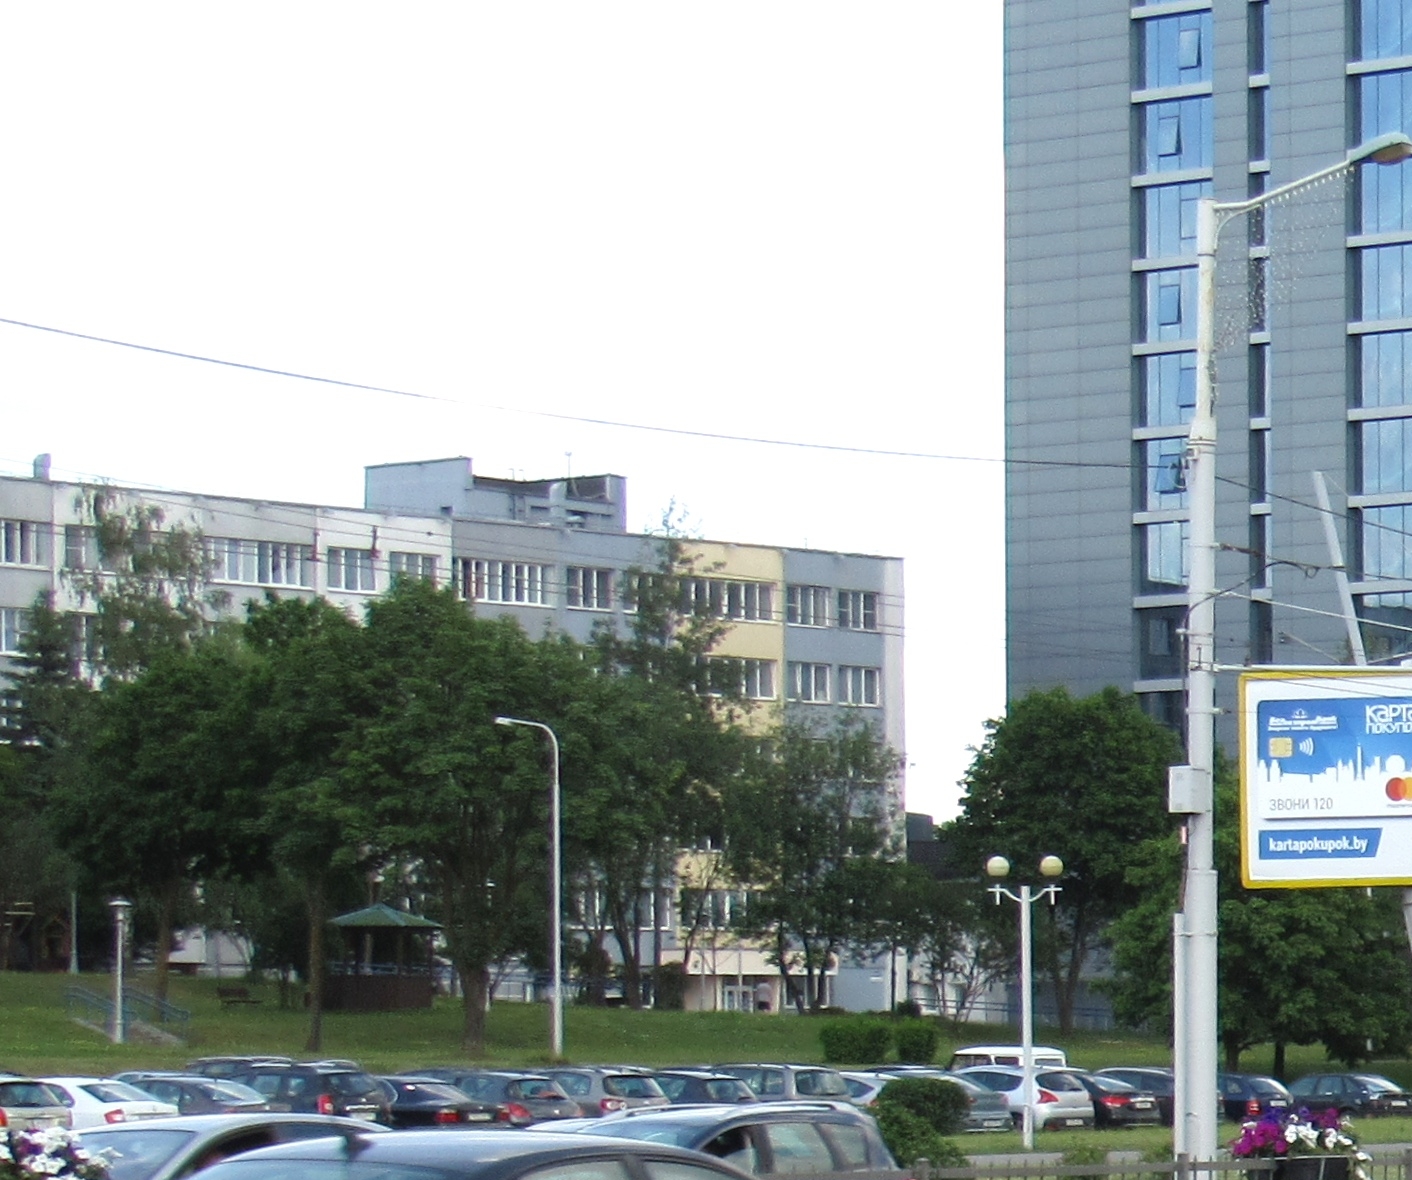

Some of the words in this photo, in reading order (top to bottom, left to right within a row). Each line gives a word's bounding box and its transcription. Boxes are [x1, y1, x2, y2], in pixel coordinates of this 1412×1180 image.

[1269, 799, 1310, 811] ЗВОНИ
[1314, 798, 1333, 810] 120
[1269, 836, 1368, 854] kartapokupok.by
